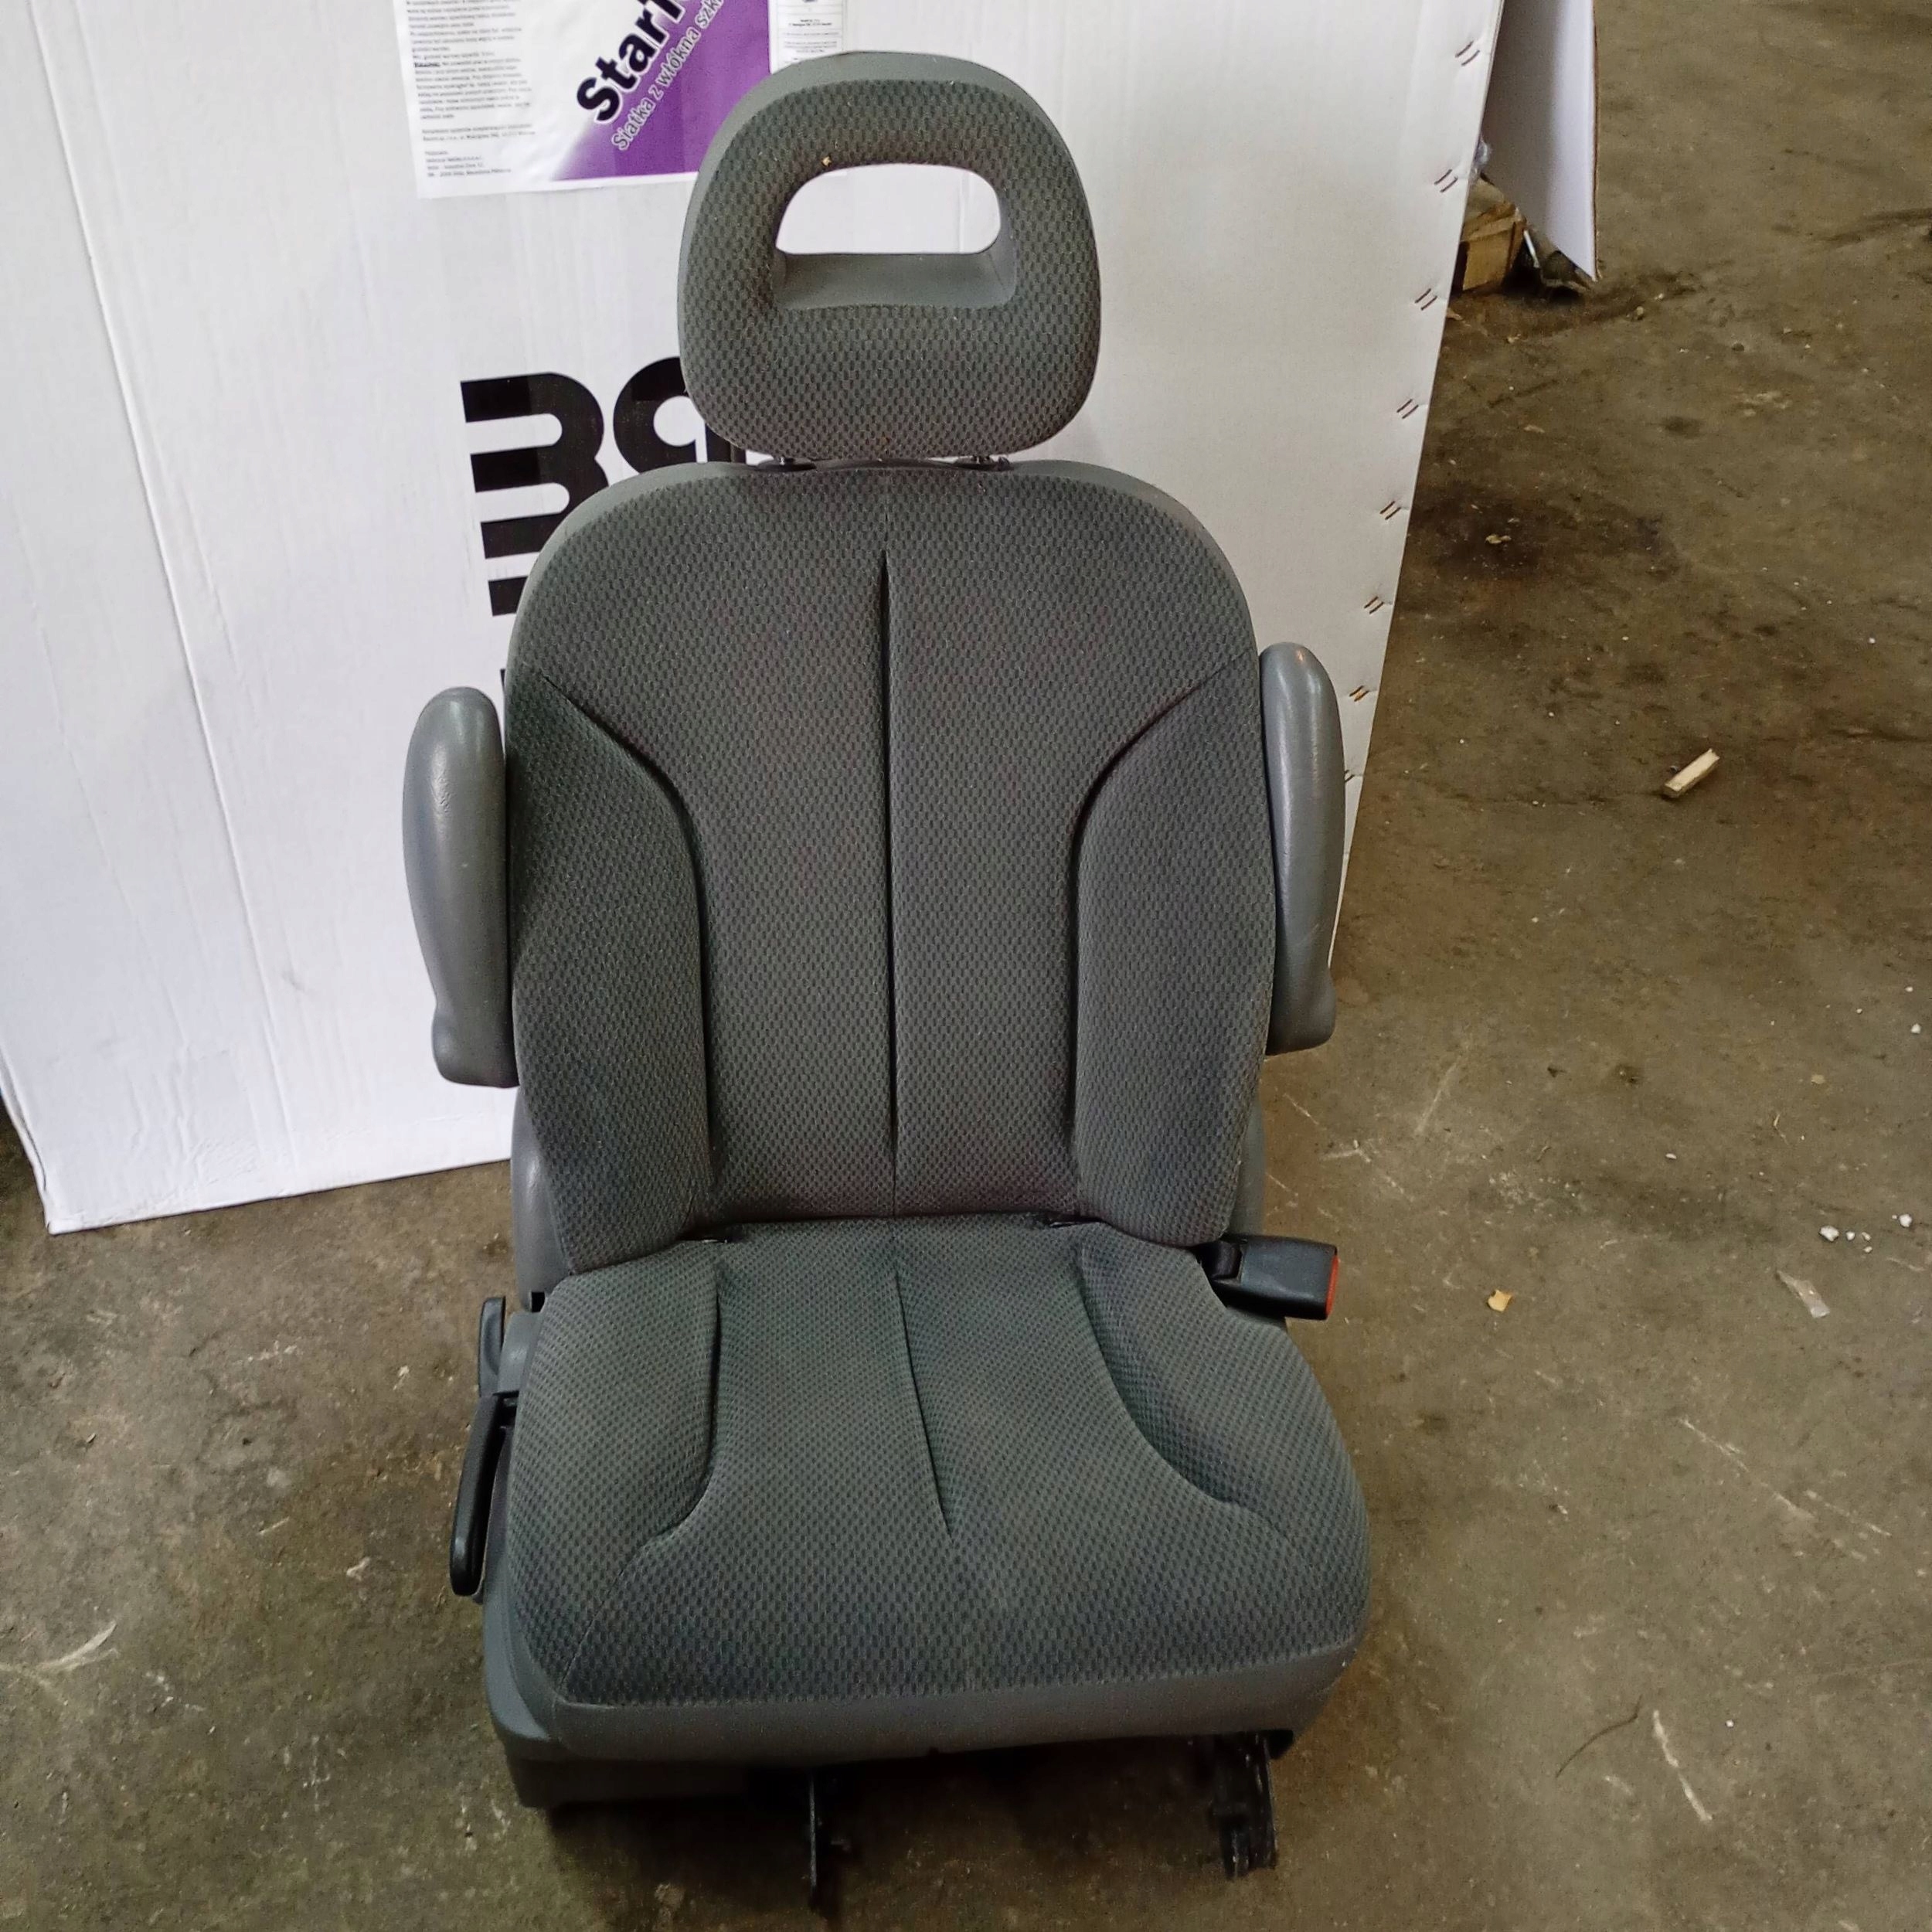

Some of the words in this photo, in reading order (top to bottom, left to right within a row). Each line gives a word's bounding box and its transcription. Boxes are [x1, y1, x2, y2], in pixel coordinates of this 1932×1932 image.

[613, 99, 655, 149] Siatka
[650, 86, 662, 100] z
[658, 28, 699, 87] włókna
[696, 0, 723, 28] szk
